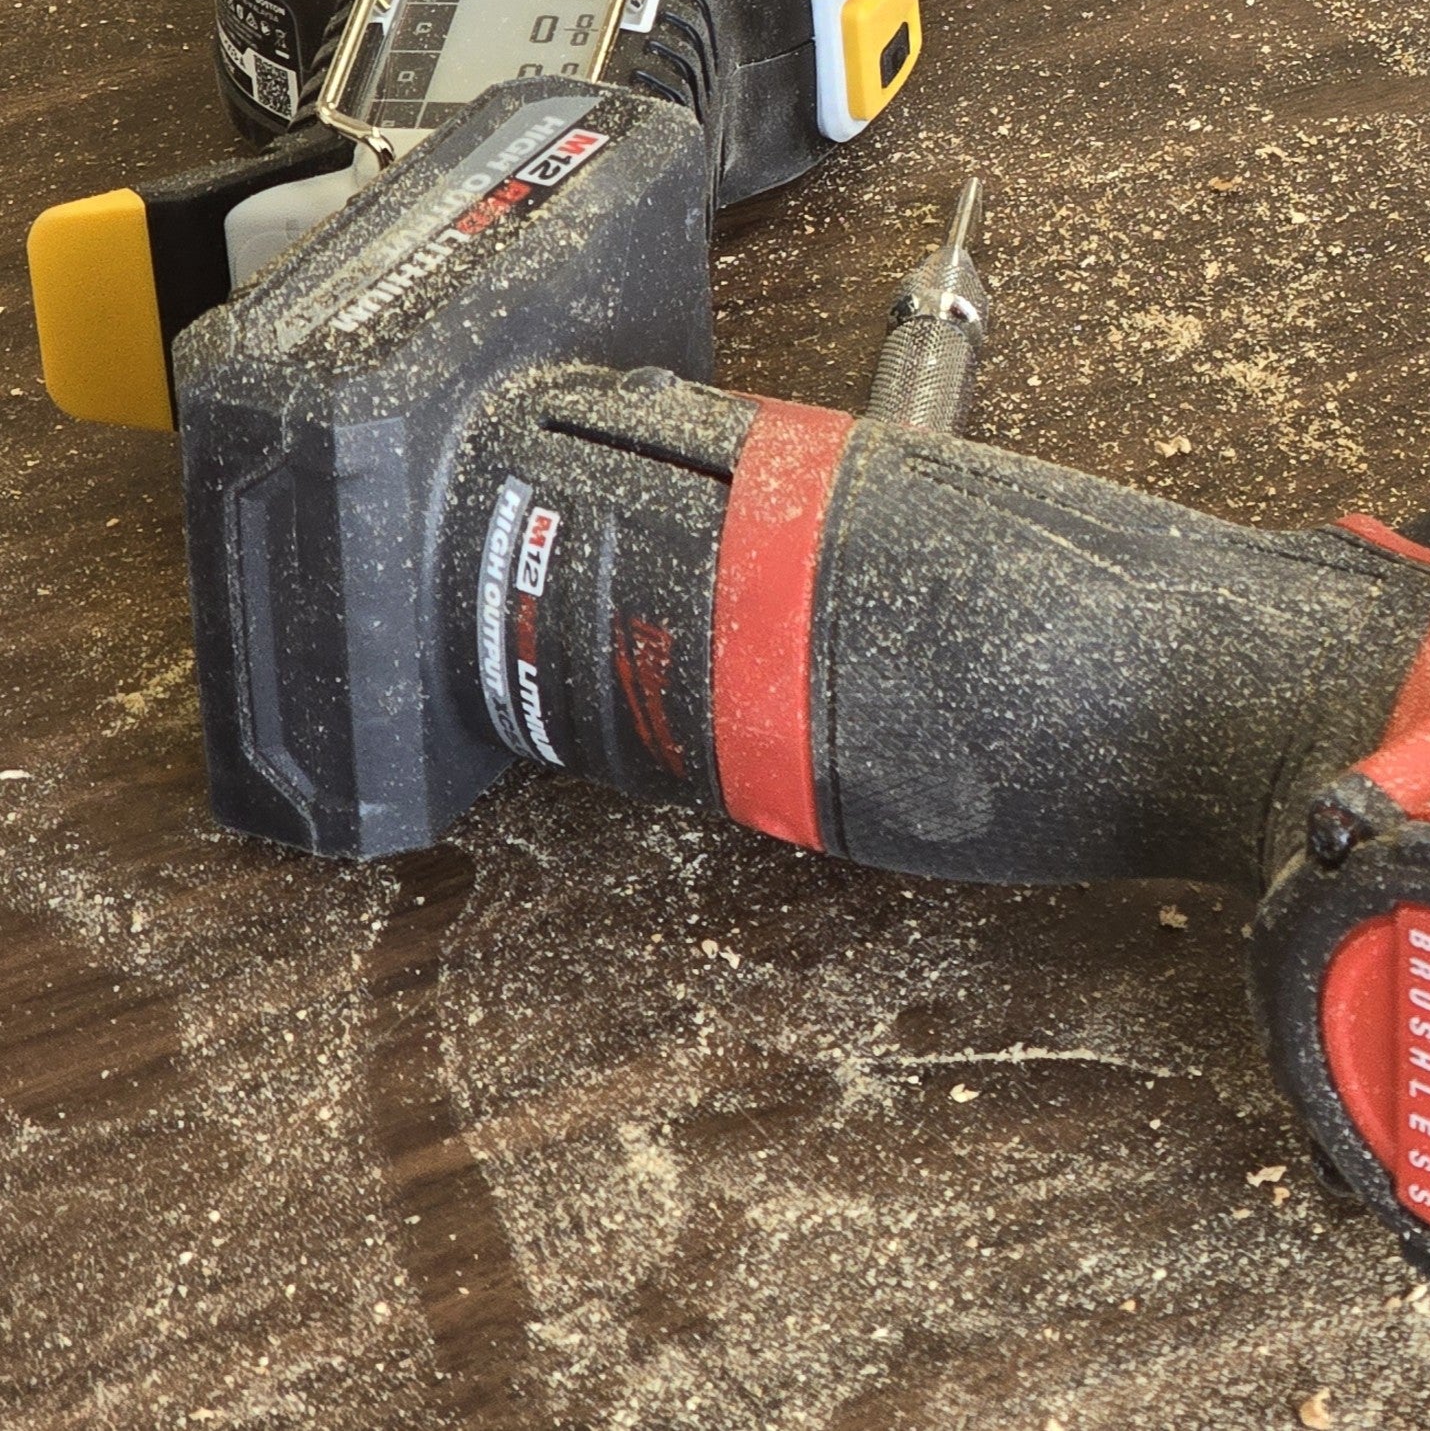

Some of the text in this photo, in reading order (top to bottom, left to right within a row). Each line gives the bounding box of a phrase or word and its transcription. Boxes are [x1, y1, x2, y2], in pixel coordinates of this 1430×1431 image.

[529, 14, 559, 43] 0
[486, 115, 565, 172] HIGH
[530, 130, 599, 184] M12
[488, 489, 521, 583] HIGH
[521, 514, 553, 590] M12
[483, 583, 504, 698] OUTPUT
